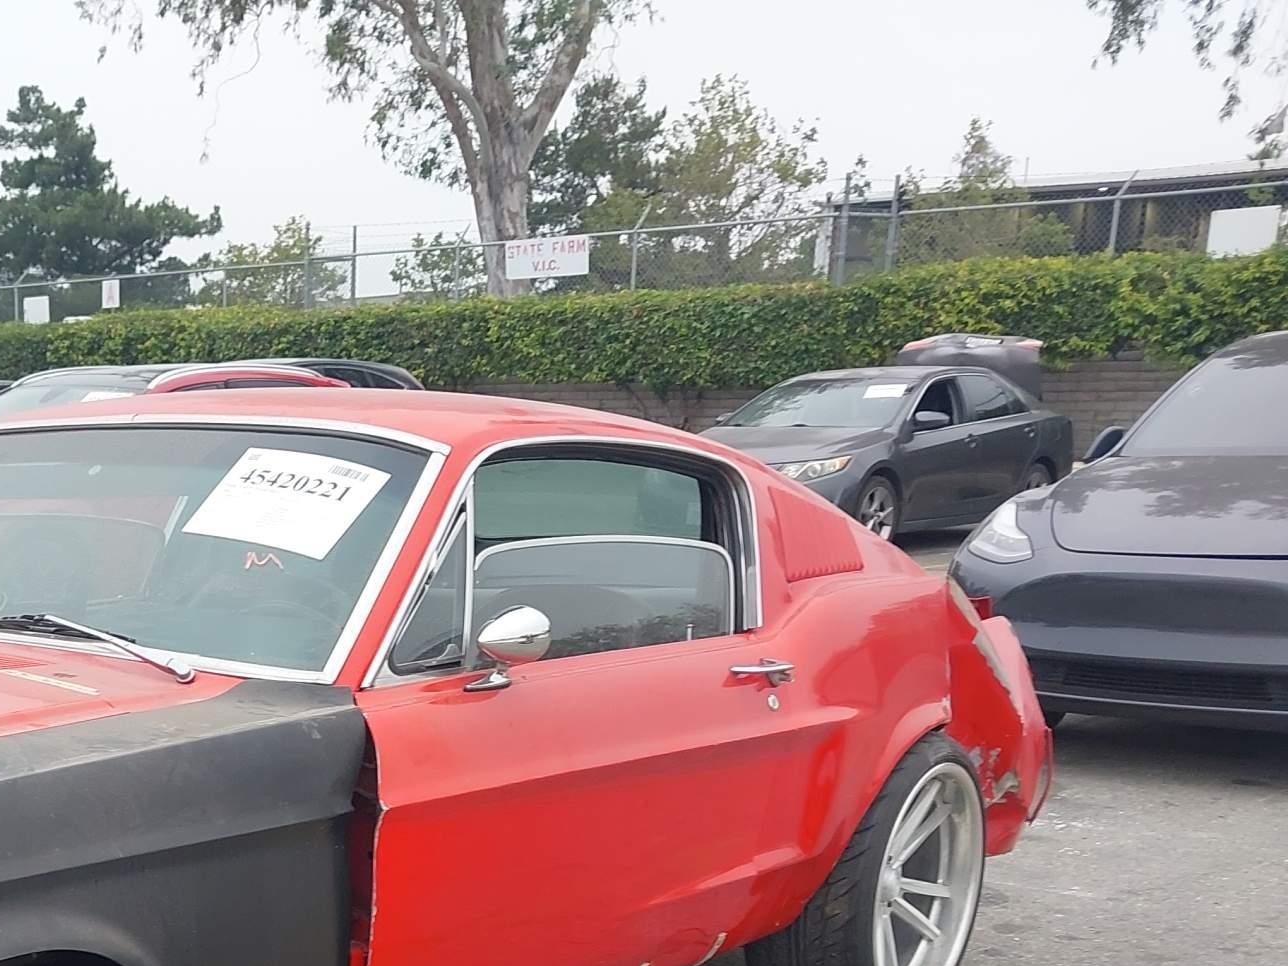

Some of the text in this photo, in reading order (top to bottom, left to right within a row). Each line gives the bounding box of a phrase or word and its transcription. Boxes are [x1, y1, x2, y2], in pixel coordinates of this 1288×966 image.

[507, 239, 586, 258] STATE FARM
[240, 468, 352, 501] 45420221
